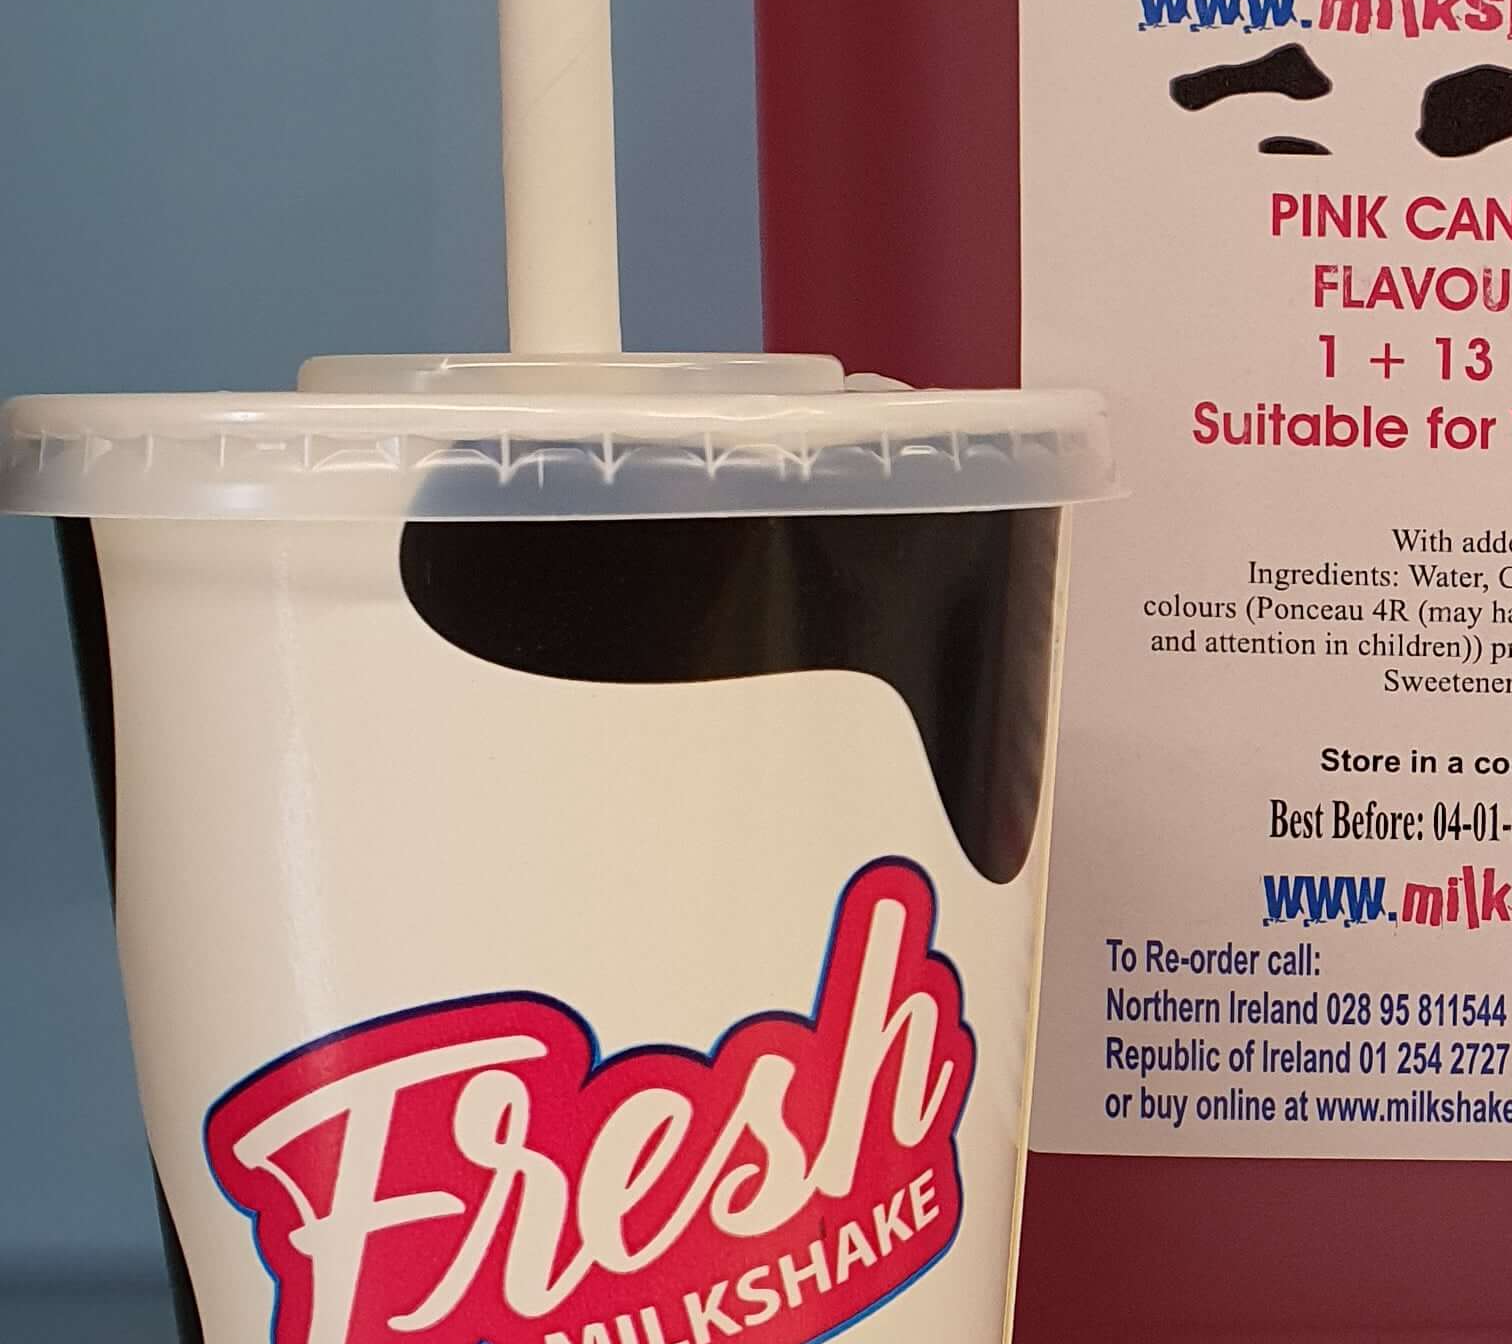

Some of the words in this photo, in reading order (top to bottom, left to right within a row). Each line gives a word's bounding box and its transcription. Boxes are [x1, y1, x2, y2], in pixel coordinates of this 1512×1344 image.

[1271, 192, 1388, 239] PINK
[1318, 334, 1335, 378] 1
[1435, 336, 1493, 382] 13
[1192, 401, 1409, 449] Suitable
[1426, 406, 1497, 450] for
[1391, 528, 1452, 553] With
[1249, 560, 1399, 591] Ingredients:
[1407, 564, 1489, 593] Water,
[1143, 593, 1237, 619] colours
[1246, 595, 1364, 625] (Ponceau
[1372, 598, 1409, 622] 4R
[1418, 599, 1483, 630] (may
[1151, 629, 1197, 653] and
[1205, 631, 1316, 655] attention
[1325, 631, 1348, 656] in
[1358, 632, 1483, 665] children))
[1320, 747, 1401, 773] Store
[1411, 749, 1437, 774] in
[1447, 756, 1464, 774] a
[1269, 799, 1324, 839] Best
[1331, 799, 1424, 841] Before:
[1105, 938, 1137, 973] To
[1146, 939, 1261, 975] Re-order
[1267, 942, 1321, 977] call:
[1106, 987, 1220, 1024] Northern
[1229, 990, 1318, 1025] Ireland
[1326, 992, 1372, 1026] 028
[1379, 993, 1410, 1026] 95
[1418, 993, 1507, 1027] 811544
[1106, 1036, 1220, 1079] Republic
[1228, 1039, 1256, 1073] of
[1262, 1039, 1351, 1074] Ireland
[1359, 1041, 1386, 1074] 01
[1396, 1041, 1443, 1075] 254
[1449, 1042, 1511, 1075] 2727
[1105, 1093, 1133, 1119] or
[1140, 1085, 1189, 1129] buy
[1196, 1087, 1276, 1121] online
[1284, 1090, 1309, 1122] at
